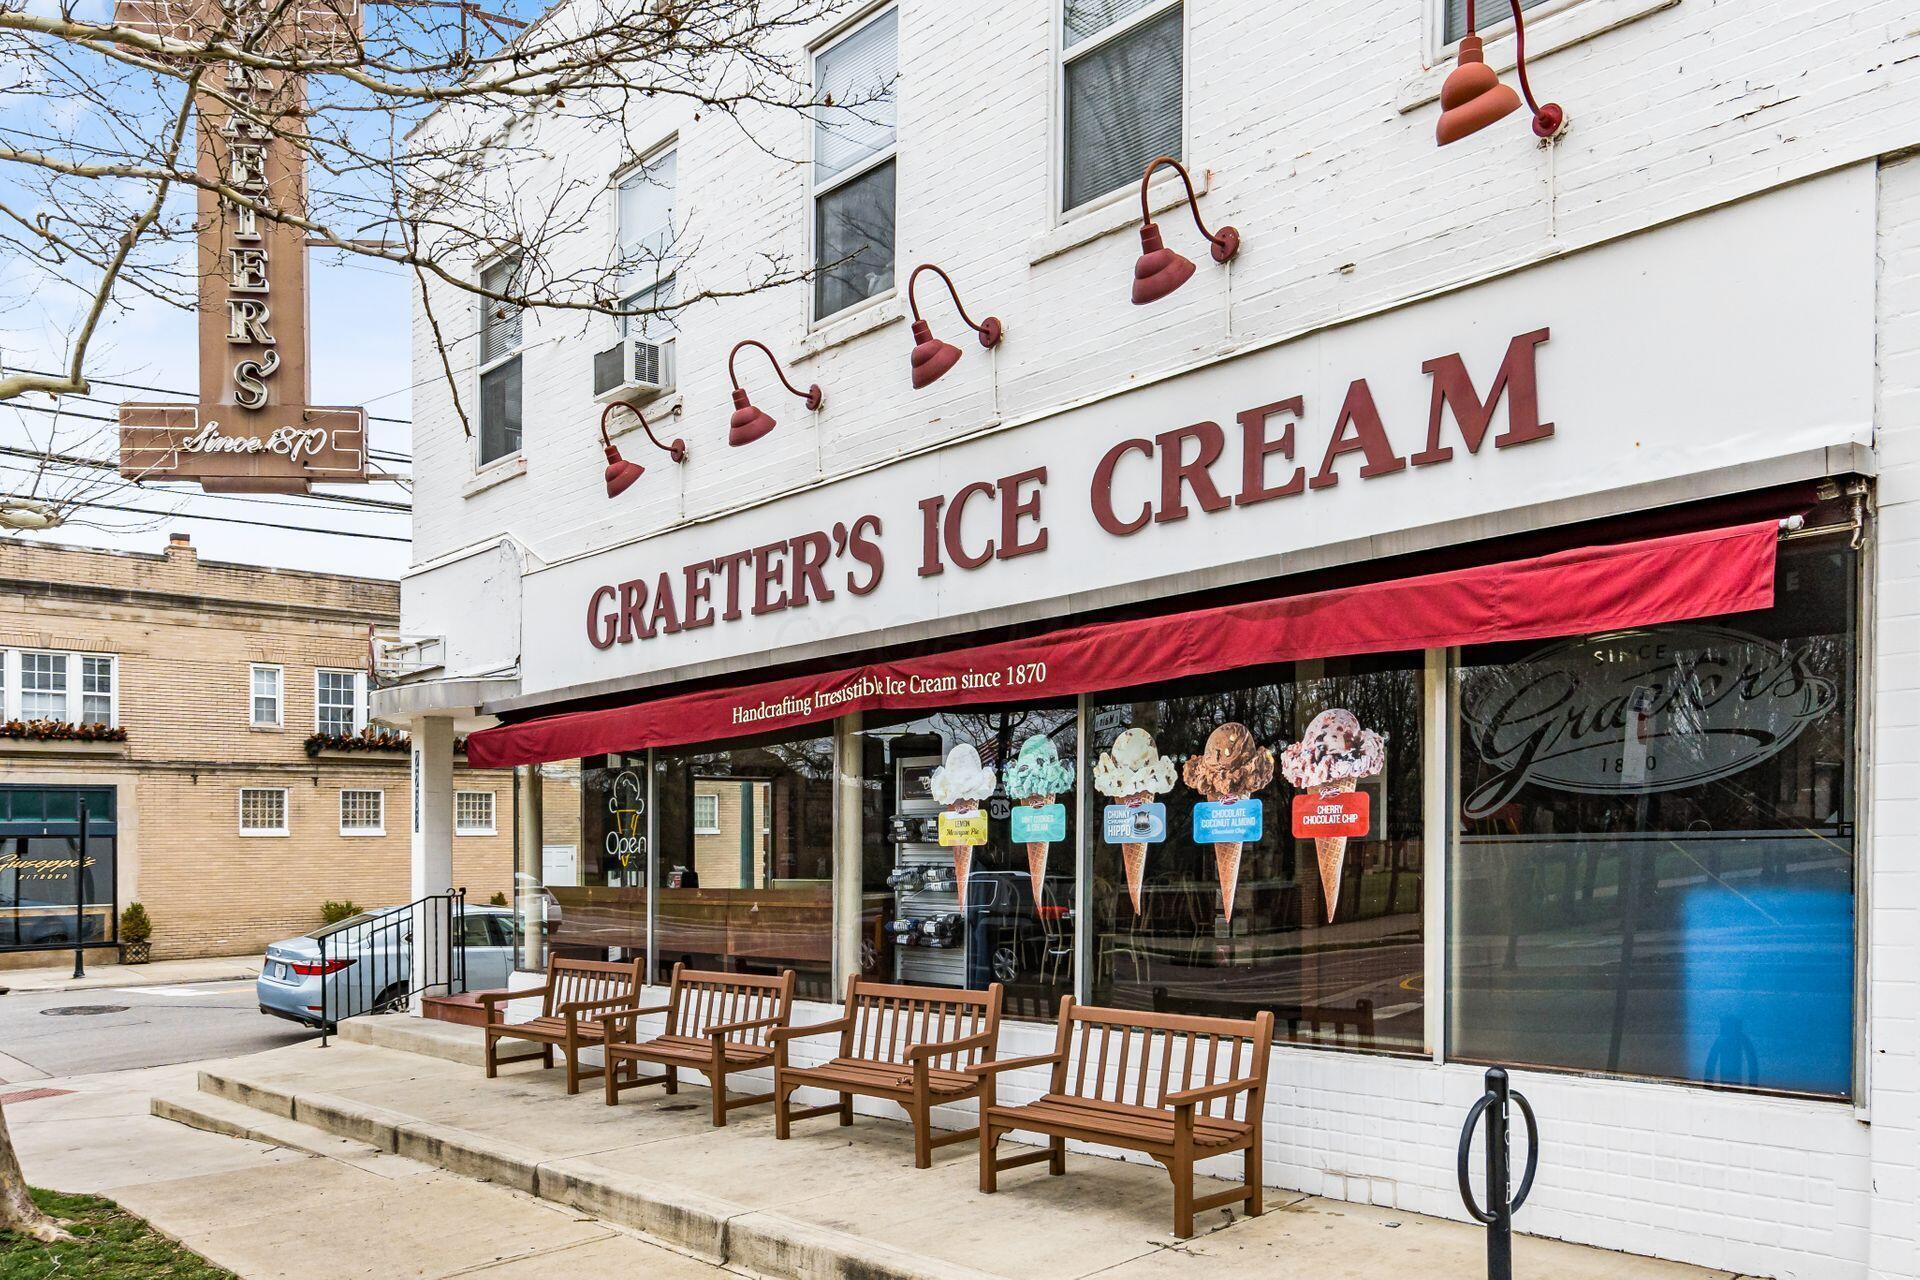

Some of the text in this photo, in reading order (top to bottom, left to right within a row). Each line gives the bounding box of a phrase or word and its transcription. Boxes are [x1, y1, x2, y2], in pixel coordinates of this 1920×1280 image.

[183, 421, 262, 453] Since
[586, 514, 885, 650] GRAETER'S
[917, 466, 1049, 577] ICE
[1091, 327, 1556, 537] CREAM
[732, 695, 812, 725] Handcrafting
[886, 676, 907, 695] Ice
[909, 674, 958, 694] Cream
[961, 668, 1002, 690] since
[1006, 662, 1047, 687] 1870
[1602, 756, 1657, 773] 180
[1107, 809, 1131, 819] CHUNKY
[1211, 808, 1247, 818] CHOCOLATE
[1317, 804, 1344, 814] CHERRY
[1201, 816, 1256, 828] COCONUT ALMOND
[1302, 813, 1359, 825] CHOCOLATE CHIP
[1107, 824, 1131, 837] HIPPO
[606, 831, 647, 860] Open
[19, 873, 68, 881] RITROVO
